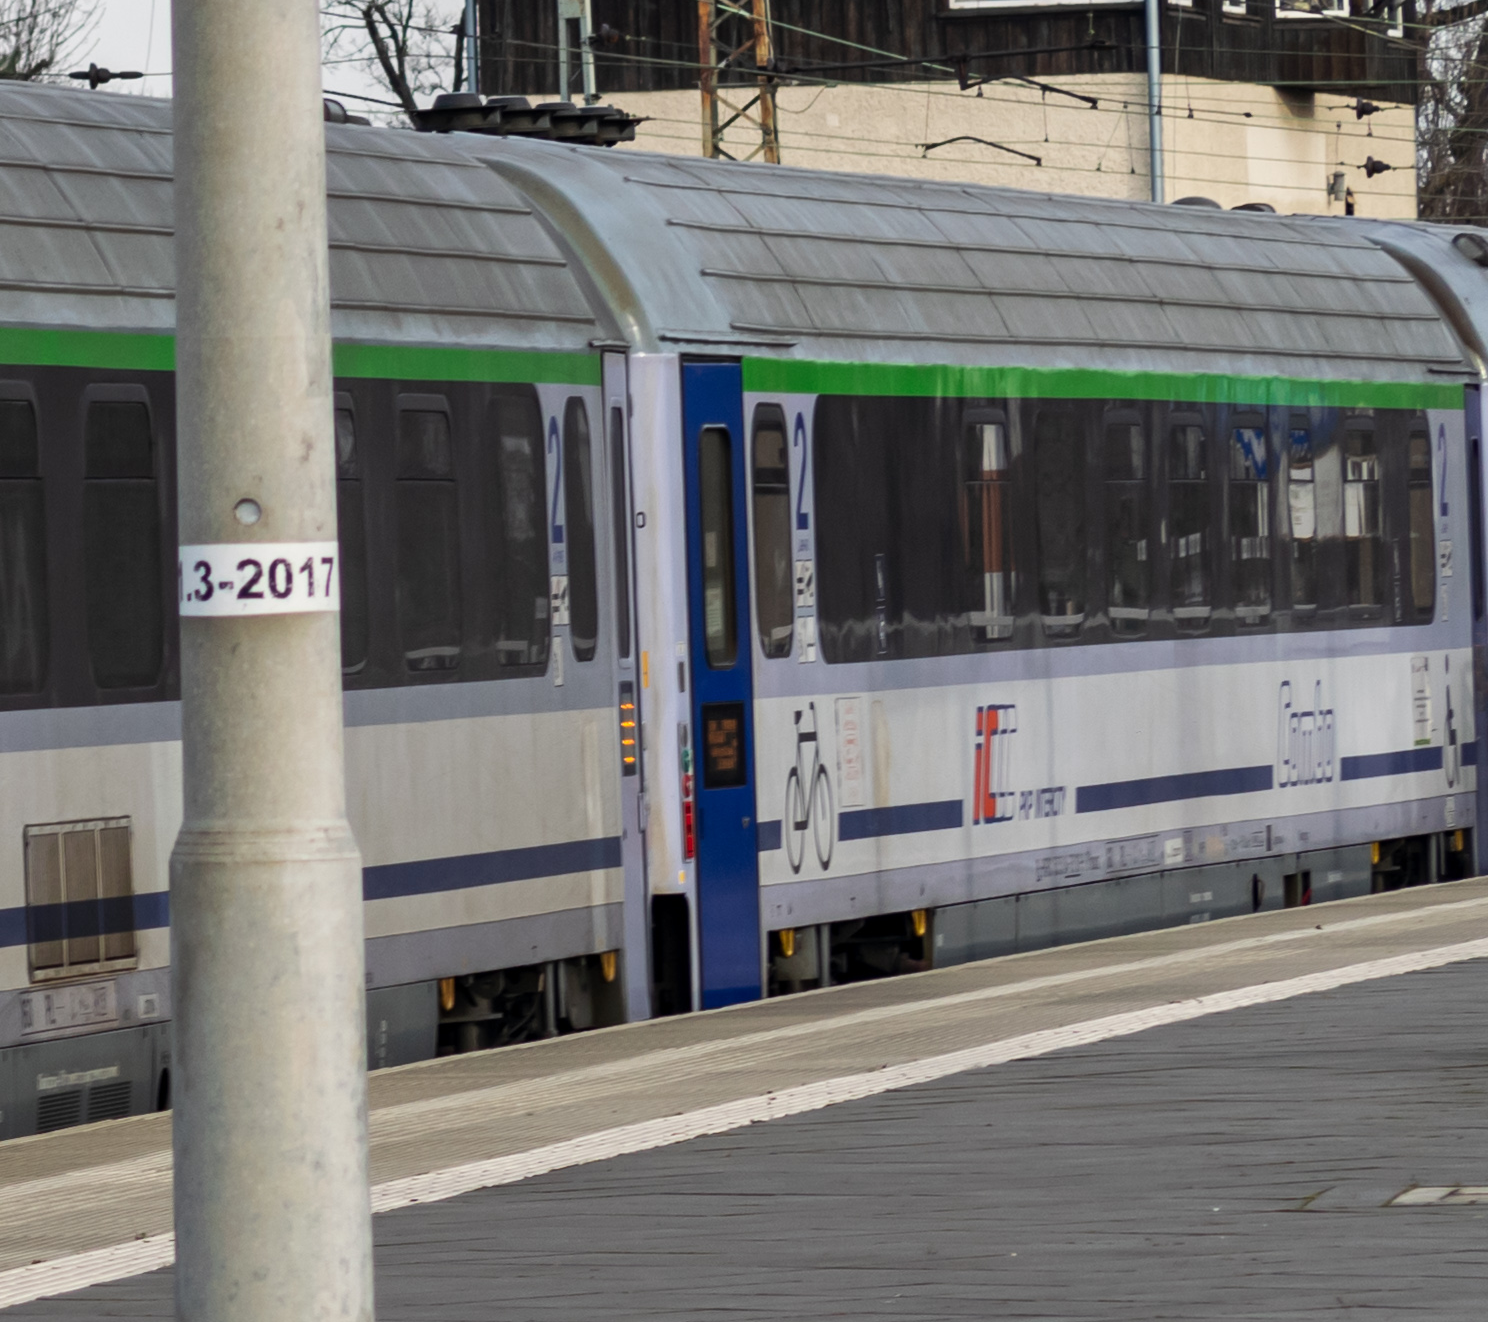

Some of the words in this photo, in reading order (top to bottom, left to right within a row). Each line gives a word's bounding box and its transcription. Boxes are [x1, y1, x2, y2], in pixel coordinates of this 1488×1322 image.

[548, 415, 564, 543] 2
[794, 411, 809, 530] 2
[1438, 422, 1448, 517] 2
